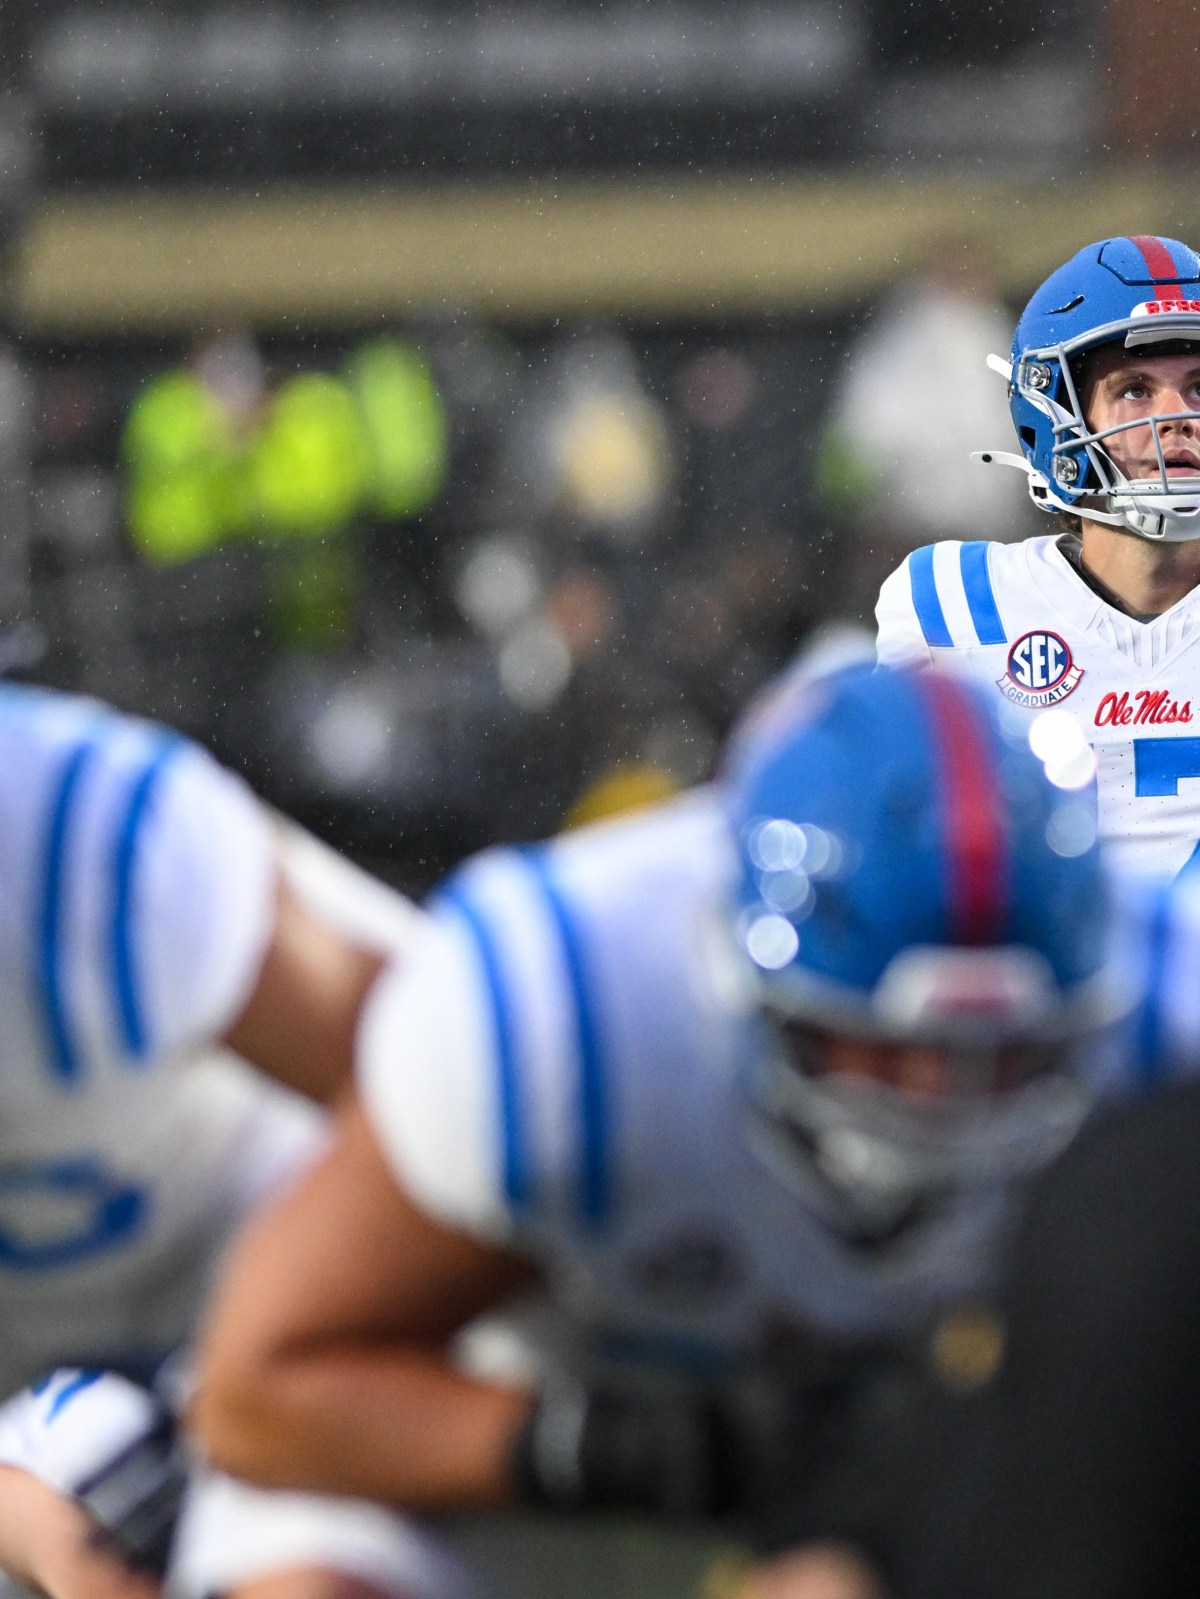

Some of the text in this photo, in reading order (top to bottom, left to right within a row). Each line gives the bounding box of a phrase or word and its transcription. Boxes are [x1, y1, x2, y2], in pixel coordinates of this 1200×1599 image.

[1012, 635, 1064, 687] SEC
[1007, 681, 1072, 707] GRADUATE
[1094, 689, 1194, 726] Ole Miss
